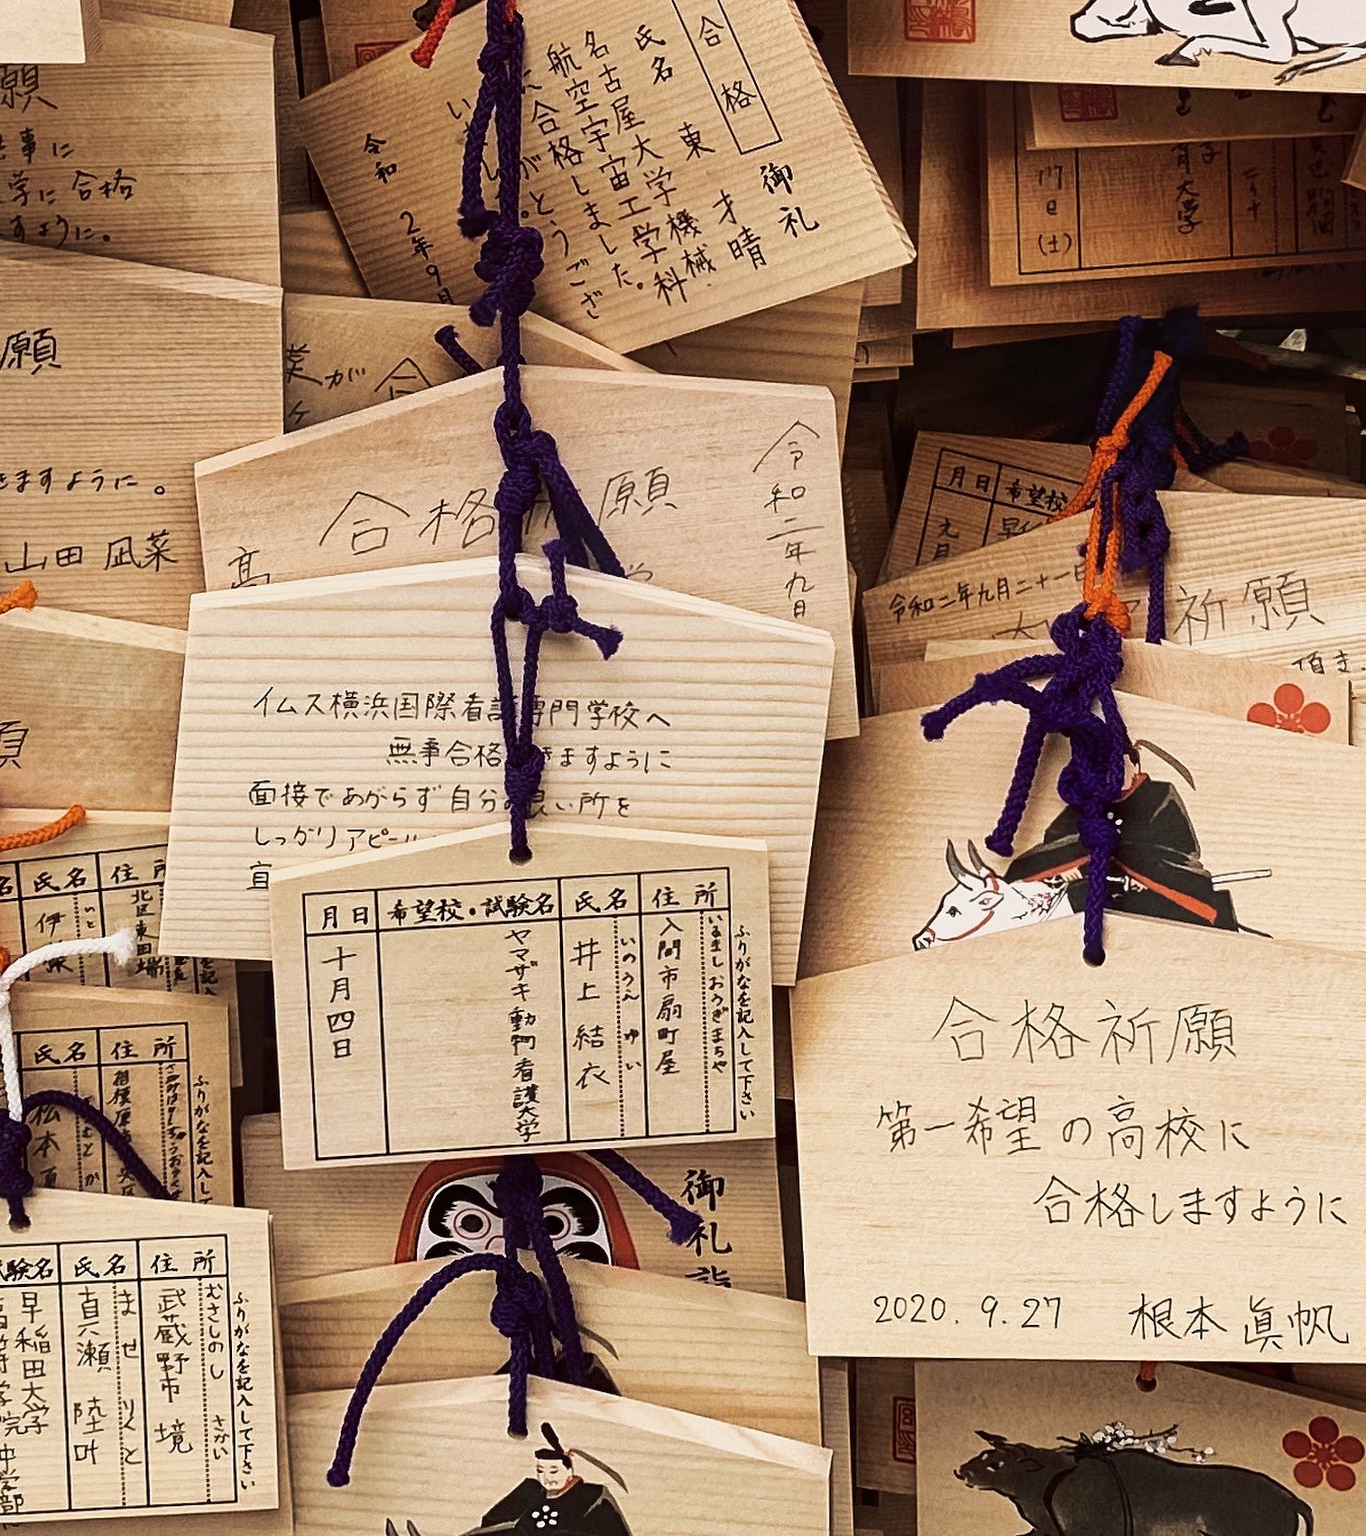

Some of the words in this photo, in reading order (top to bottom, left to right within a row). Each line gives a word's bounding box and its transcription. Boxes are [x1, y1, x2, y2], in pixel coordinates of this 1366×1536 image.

[634, 24, 674, 84] 氏名
[761, 163, 820, 238] 御礼
[34, 868, 87, 892] 氏名
[321, 905, 369, 927] 月日
[576, 887, 627, 911] 氏名
[652, 883, 716, 906] 住所
[34, 1043, 86, 1064] 氏名
[111, 1036, 175, 1058] 住所
[733, 926, 755, 1121] ふりがなを記入して下さい
[932, 997, 1237, 1066] 合格祈願
[876, 1095, 1250, 1157] 第一希望の高校に
[1034, 1175, 1348, 1229] 合格しますように
[74, 1254, 126, 1278] 氏名
[152, 1252, 218, 1274] 住所
[233, 1292, 255, 1491] ふりがなを記入して下さい
